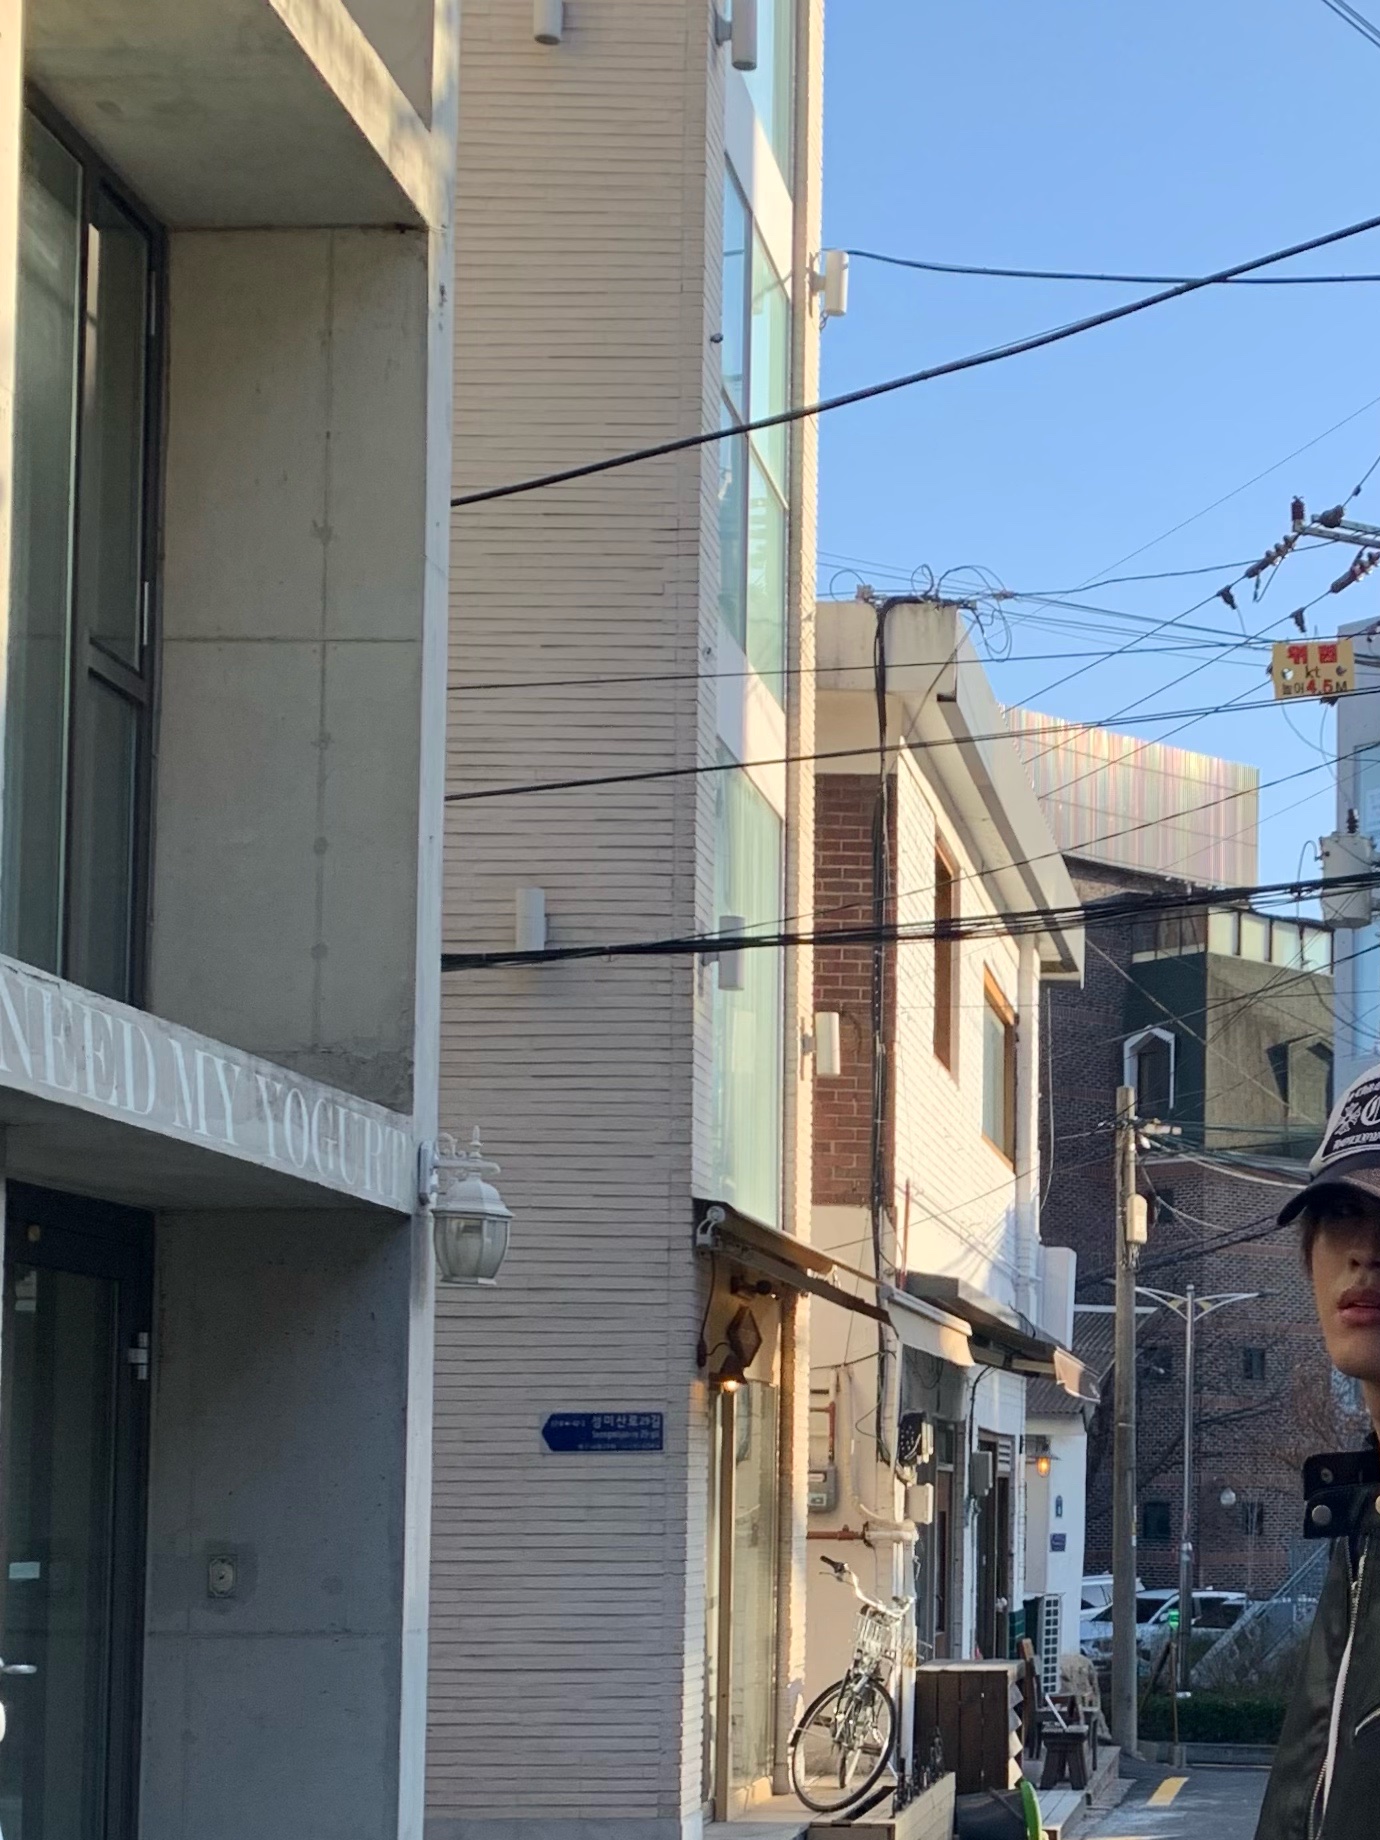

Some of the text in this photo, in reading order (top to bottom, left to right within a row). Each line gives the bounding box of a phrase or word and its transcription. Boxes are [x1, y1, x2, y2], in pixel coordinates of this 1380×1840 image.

[1305, 665, 1321, 678] kt
[0, 971, 407, 1202] NEED MY YOGURT
